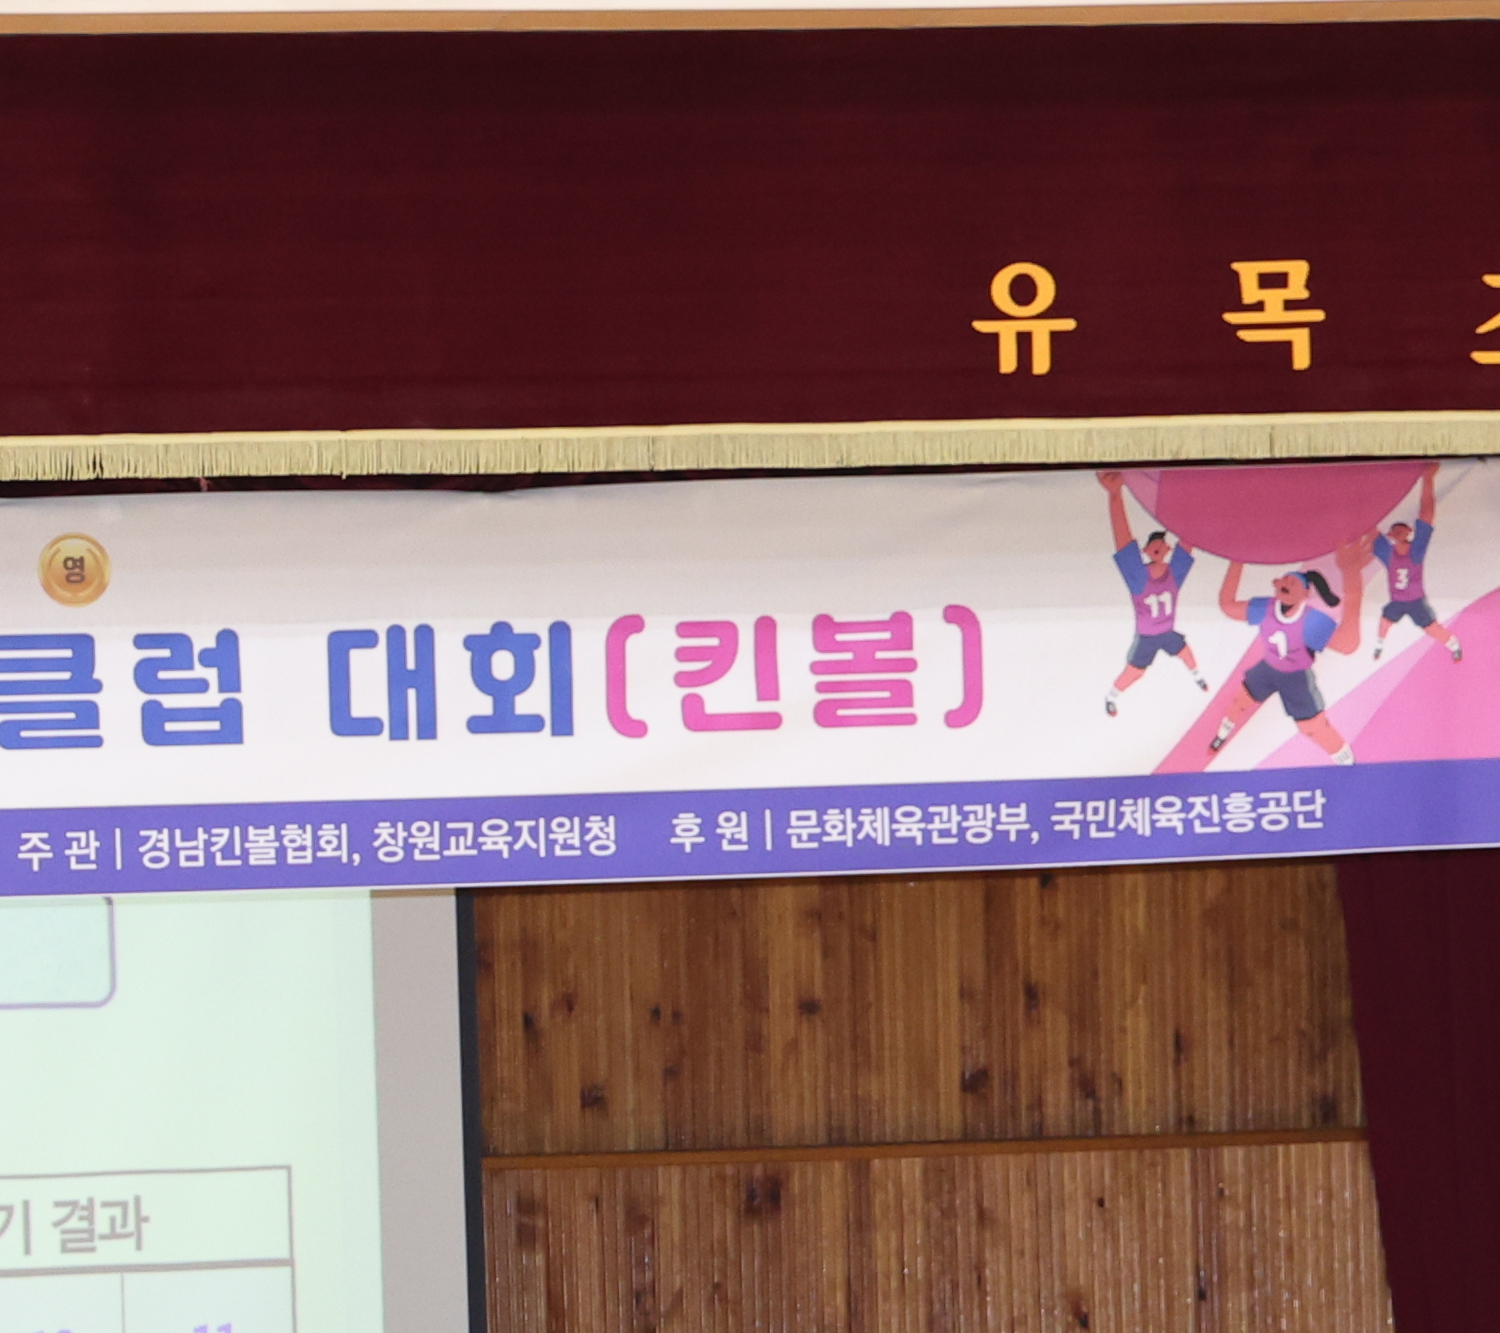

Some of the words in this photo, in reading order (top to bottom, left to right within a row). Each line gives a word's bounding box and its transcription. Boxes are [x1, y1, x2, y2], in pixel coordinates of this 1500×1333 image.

[62, 555, 86, 584] 영
[1143, 590, 1174, 618] 11
[1268, 630, 1288, 660] 1
[328, 604, 983, 741] 대회(킨볼)
[139, 823, 360, 868] 경남킨볼협회,
[373, 816, 616, 862] 창원교육지원청
[787, 803, 1039, 848] 문화체육관광부,
[1051, 789, 1326, 839] 국민체육진흥공단
[52, 1195, 150, 1254] 결과
